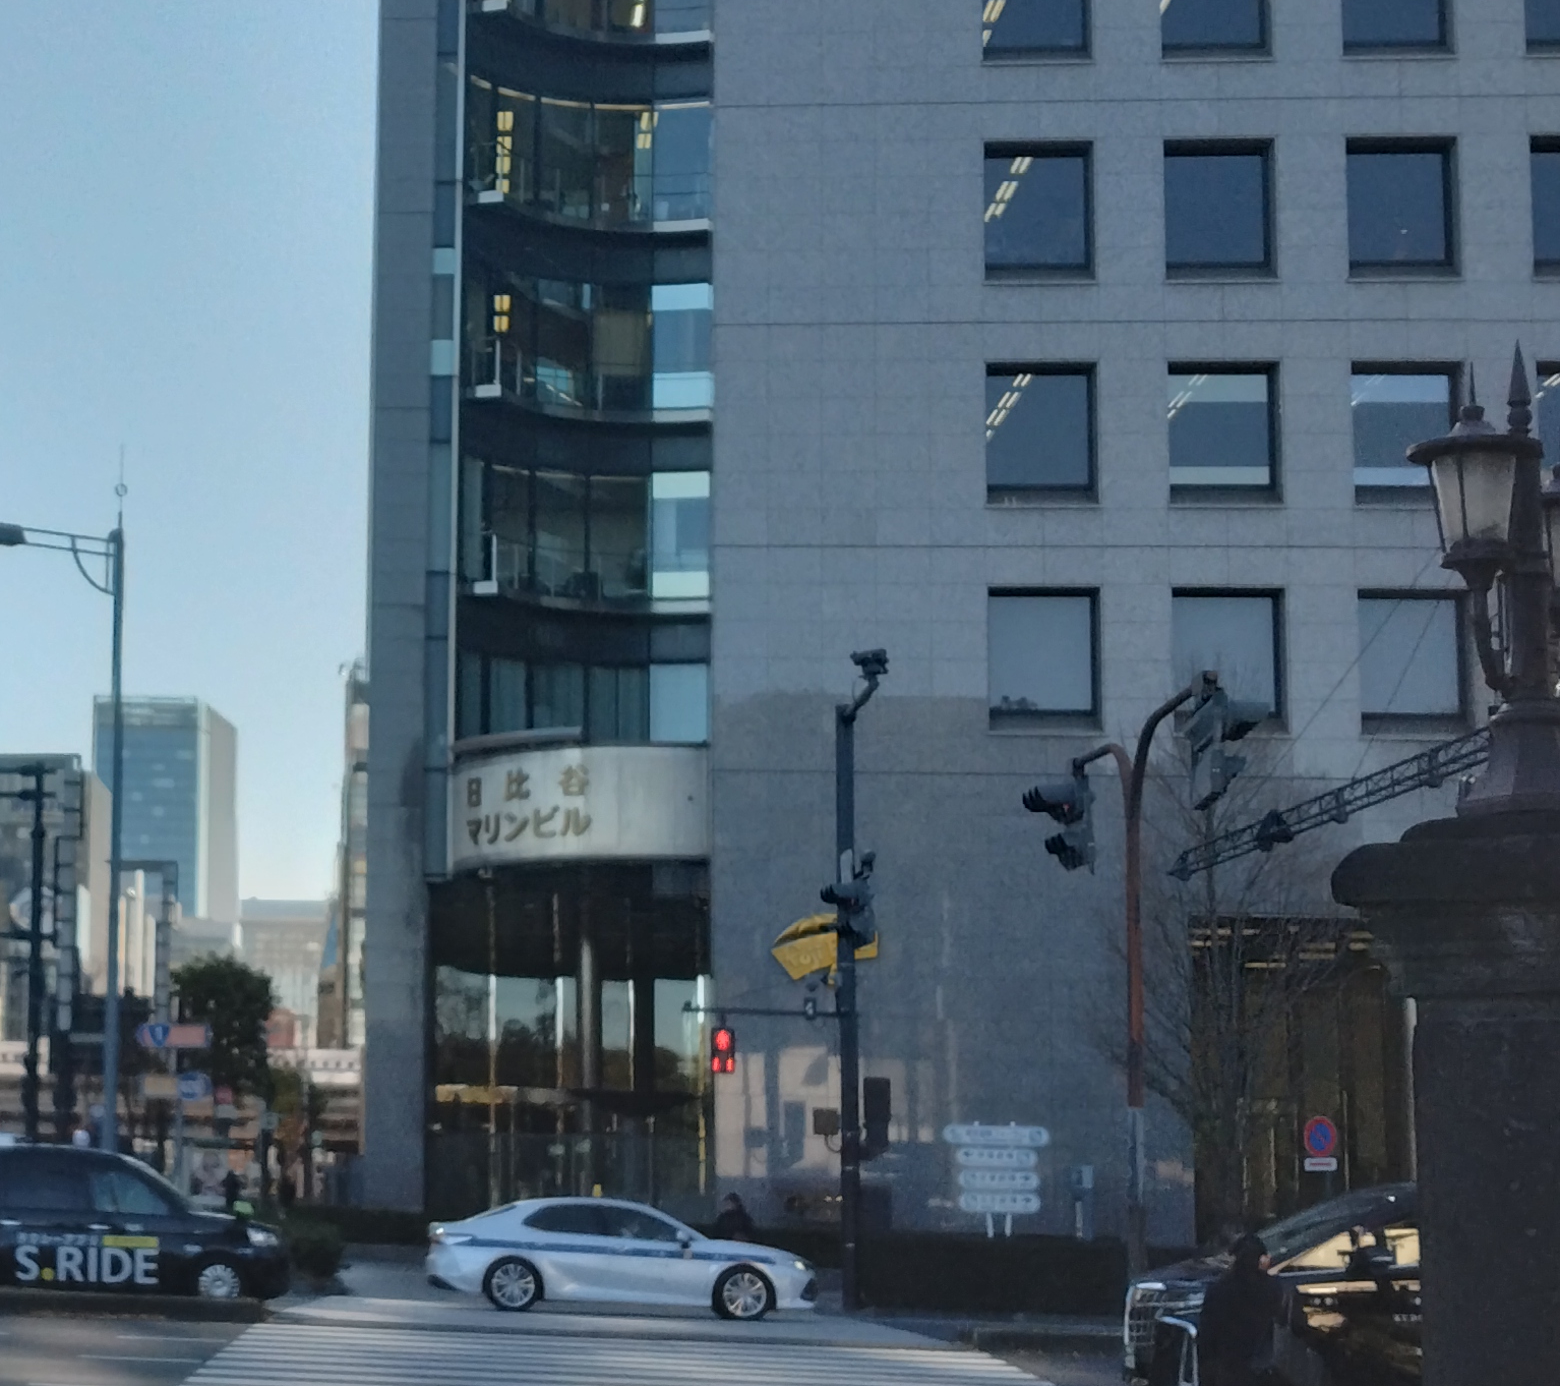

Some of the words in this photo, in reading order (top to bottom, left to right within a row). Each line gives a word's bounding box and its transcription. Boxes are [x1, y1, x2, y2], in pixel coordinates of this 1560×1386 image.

[466, 764, 589, 808] 日比谷
[466, 804, 593, 845] マリンビル
[14, 1244, 160, 1284] S.RIDE
